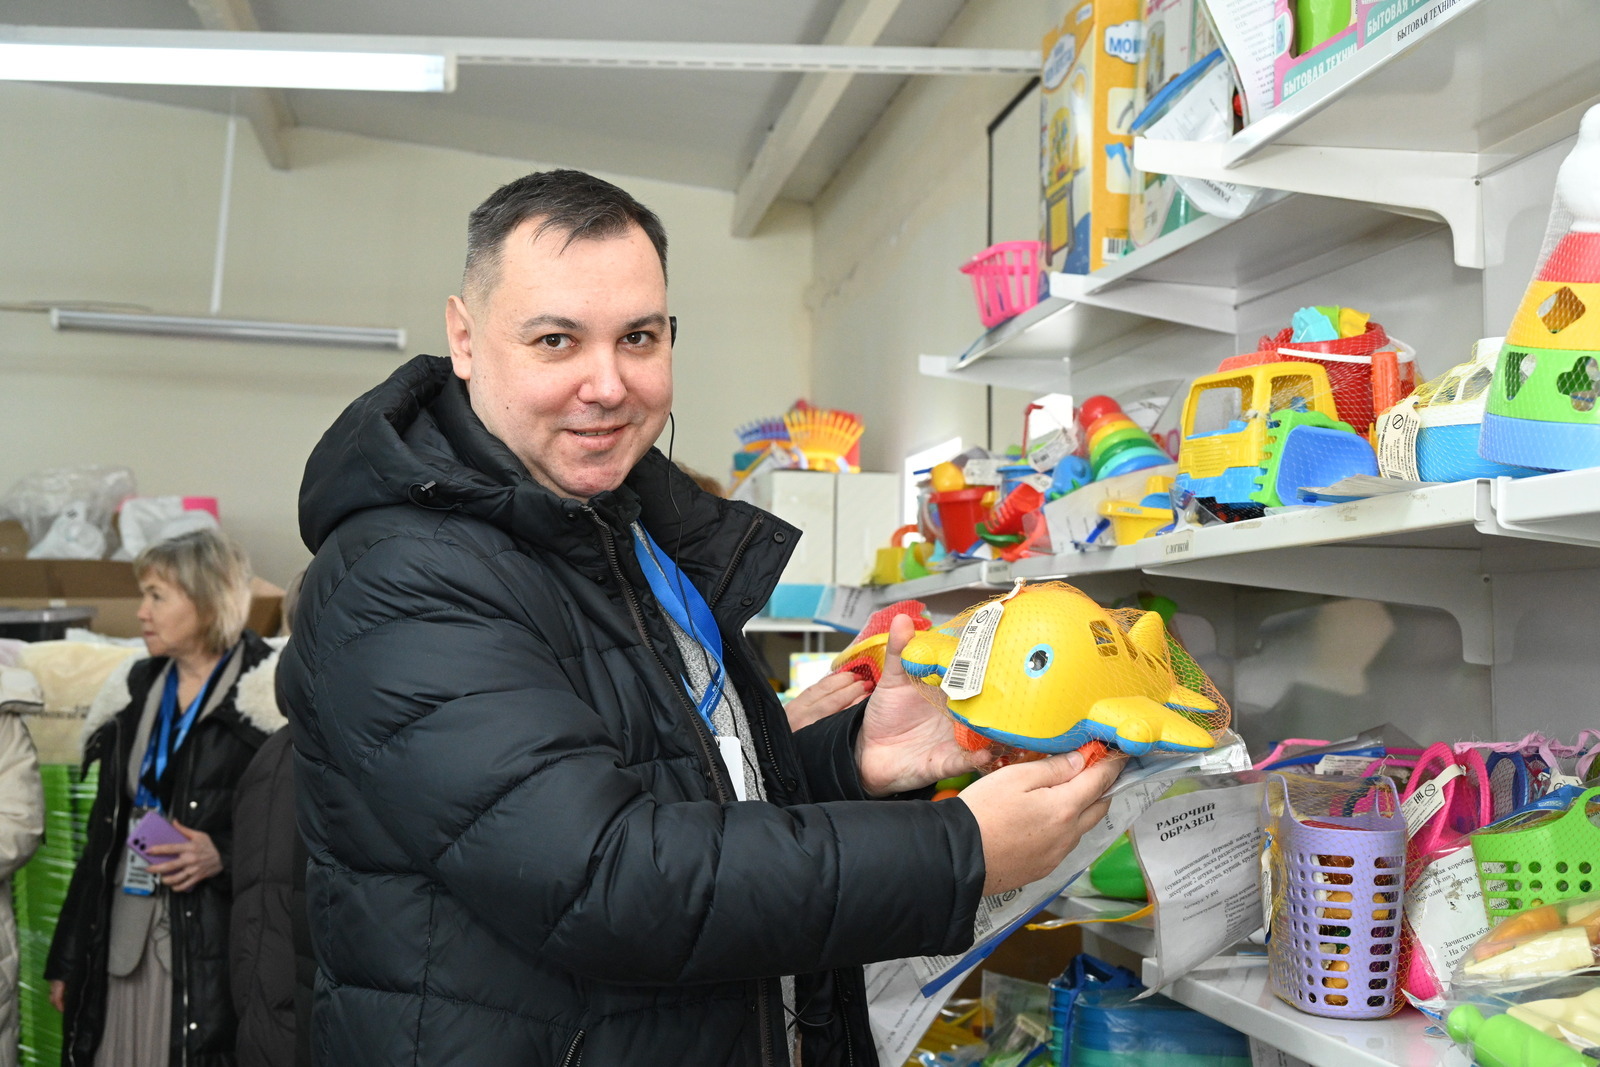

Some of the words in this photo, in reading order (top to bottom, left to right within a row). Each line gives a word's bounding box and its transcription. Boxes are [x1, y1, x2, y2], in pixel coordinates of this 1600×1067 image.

[1397, 12, 1428, 42] БЫТОВАЯ
[1283, 64, 1324, 97] БЫТОВАЯ
[1156, 802, 1216, 831] РАБОЧИЙ
[1160, 812, 1215, 842] ОБРАЗЕЦ
[1211, 840, 1234, 855] Игровой
[1443, 930, 1476, 949] Зачистить
[1448, 947, 1459, 956] На
